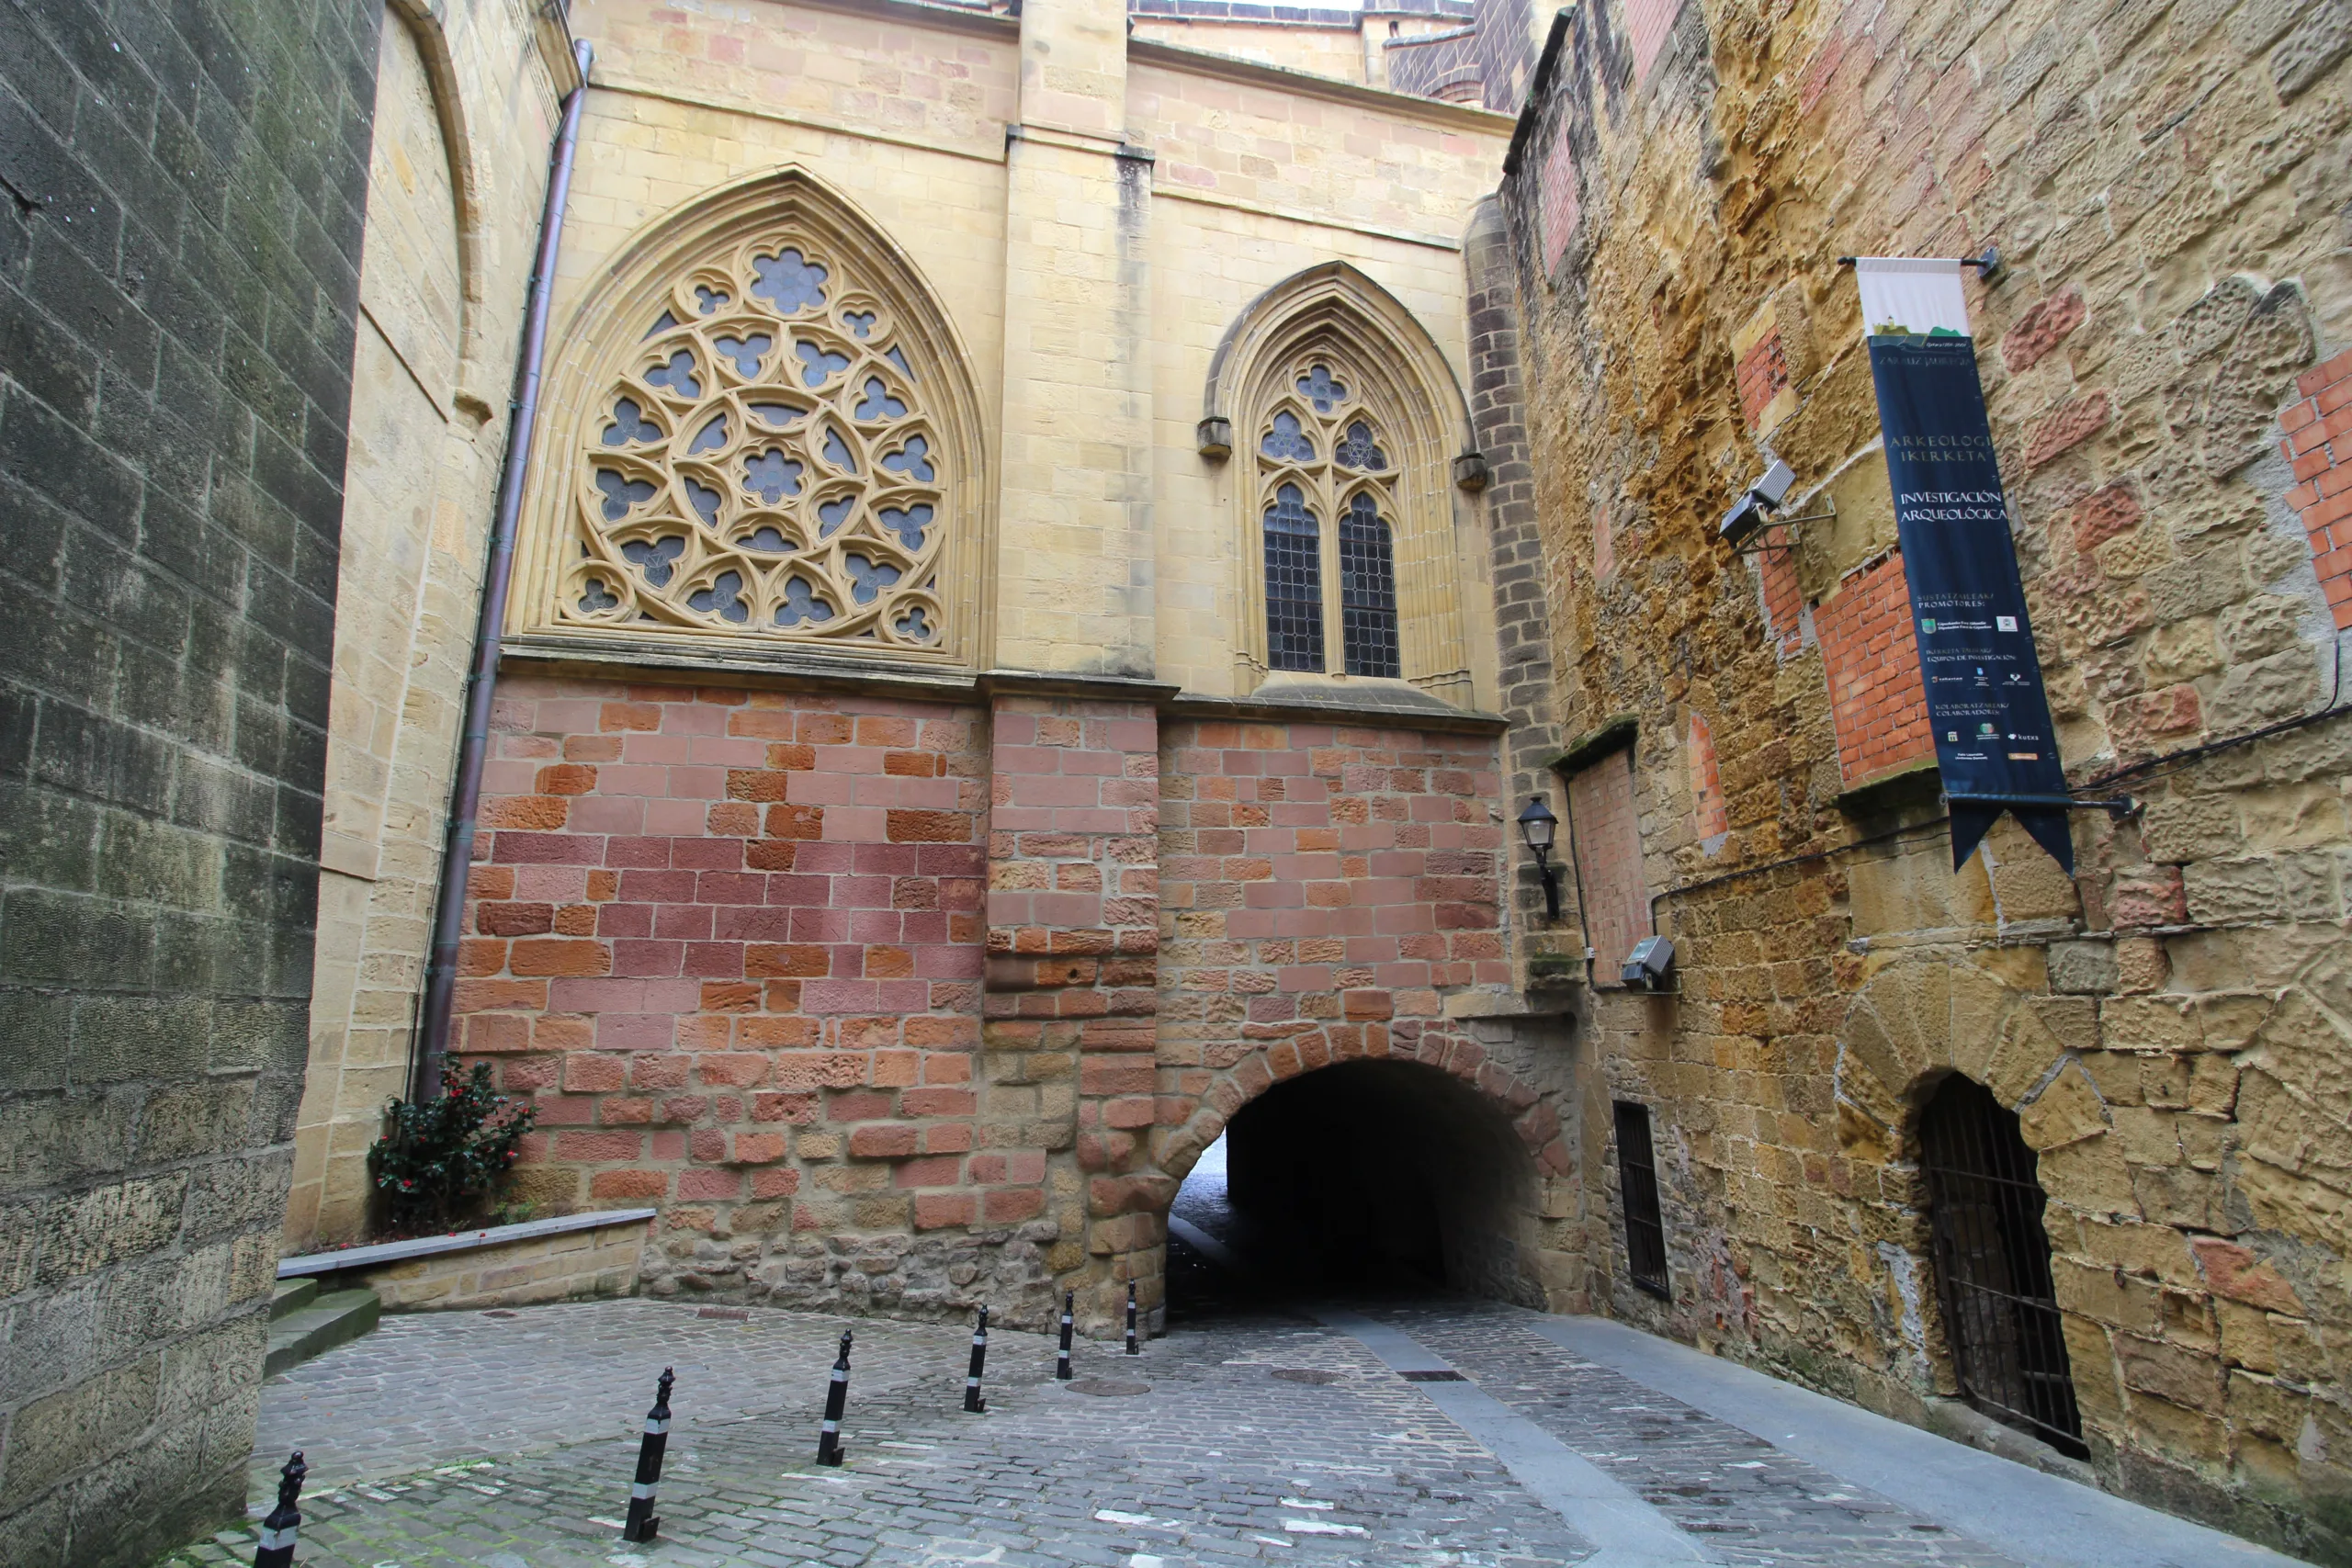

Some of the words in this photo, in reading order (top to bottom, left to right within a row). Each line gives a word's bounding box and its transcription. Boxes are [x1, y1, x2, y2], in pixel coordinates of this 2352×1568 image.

[1890, 435, 1992, 448] ARKEOLOGI
[1901, 450, 1986, 462] IKERKETA
[1900, 490, 2002, 504] INVESTIGACIÓN
[1900, 506, 2007, 523] ARQUEOLÓGICA
[1918, 600, 1985, 609] PROMOTORES:
